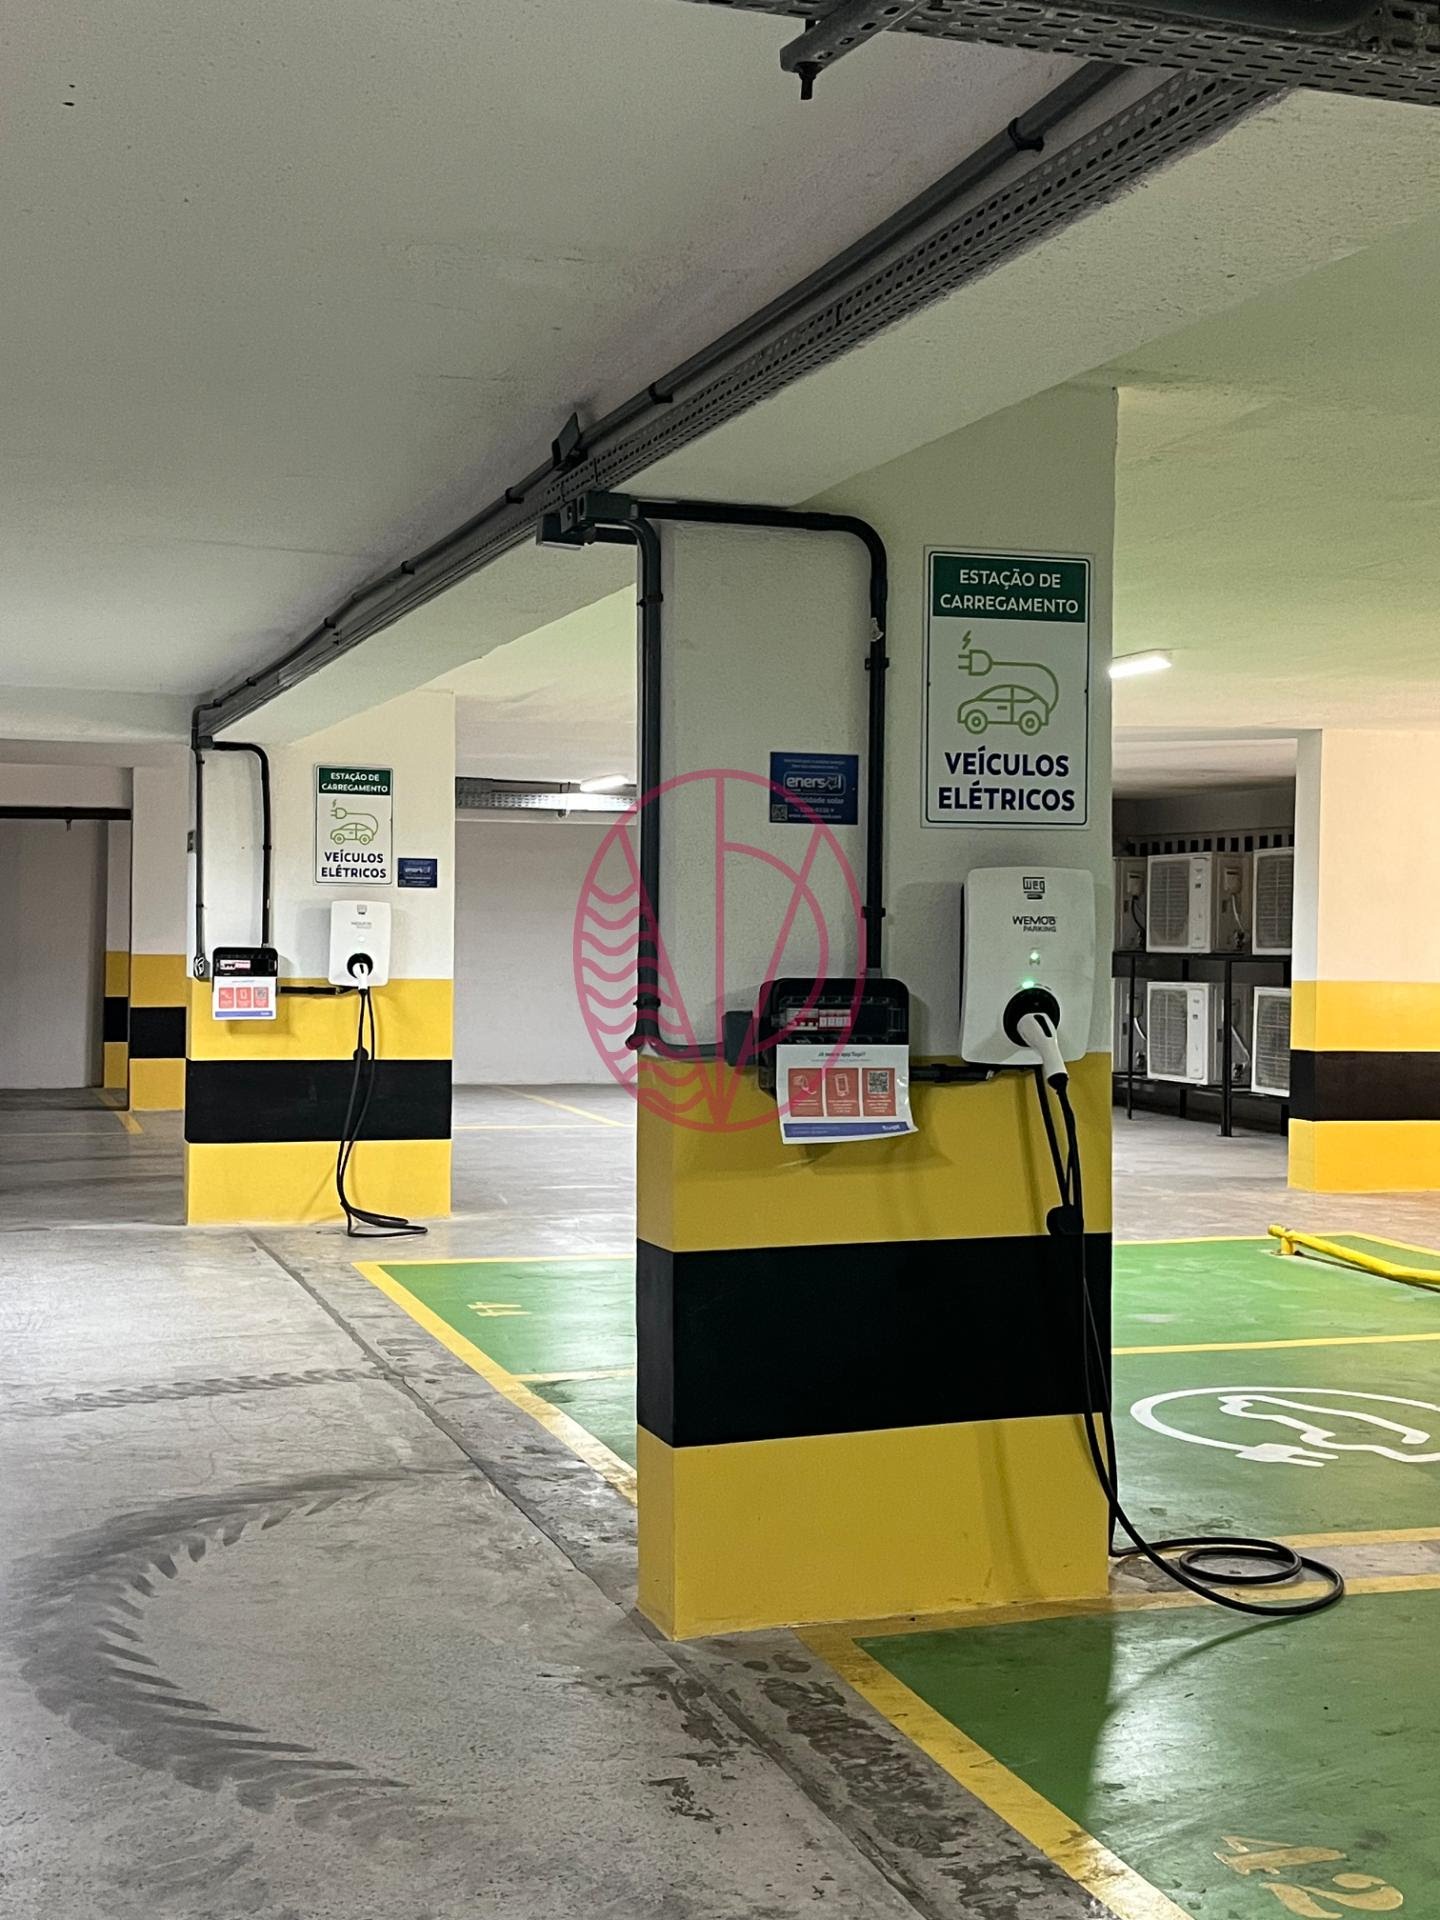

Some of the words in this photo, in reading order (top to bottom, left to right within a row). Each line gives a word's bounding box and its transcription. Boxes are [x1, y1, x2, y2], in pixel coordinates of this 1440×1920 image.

[959, 568, 1035, 590] ESTAÇÃO
[1039, 573, 1061, 589] DE
[940, 593, 1079, 614] CARREGAMENTO
[944, 745, 1070, 778] VEÍCULOS
[330, 772, 368, 782] ESTAÇÃO
[368, 774, 380, 782] DE
[321, 783, 388, 793] CARREGAMENTO
[938, 780, 1075, 812] ELÉTRICOS
[324, 849, 384, 863] VEÍCULOS
[321, 864, 387, 878] ELÉTRICOS
